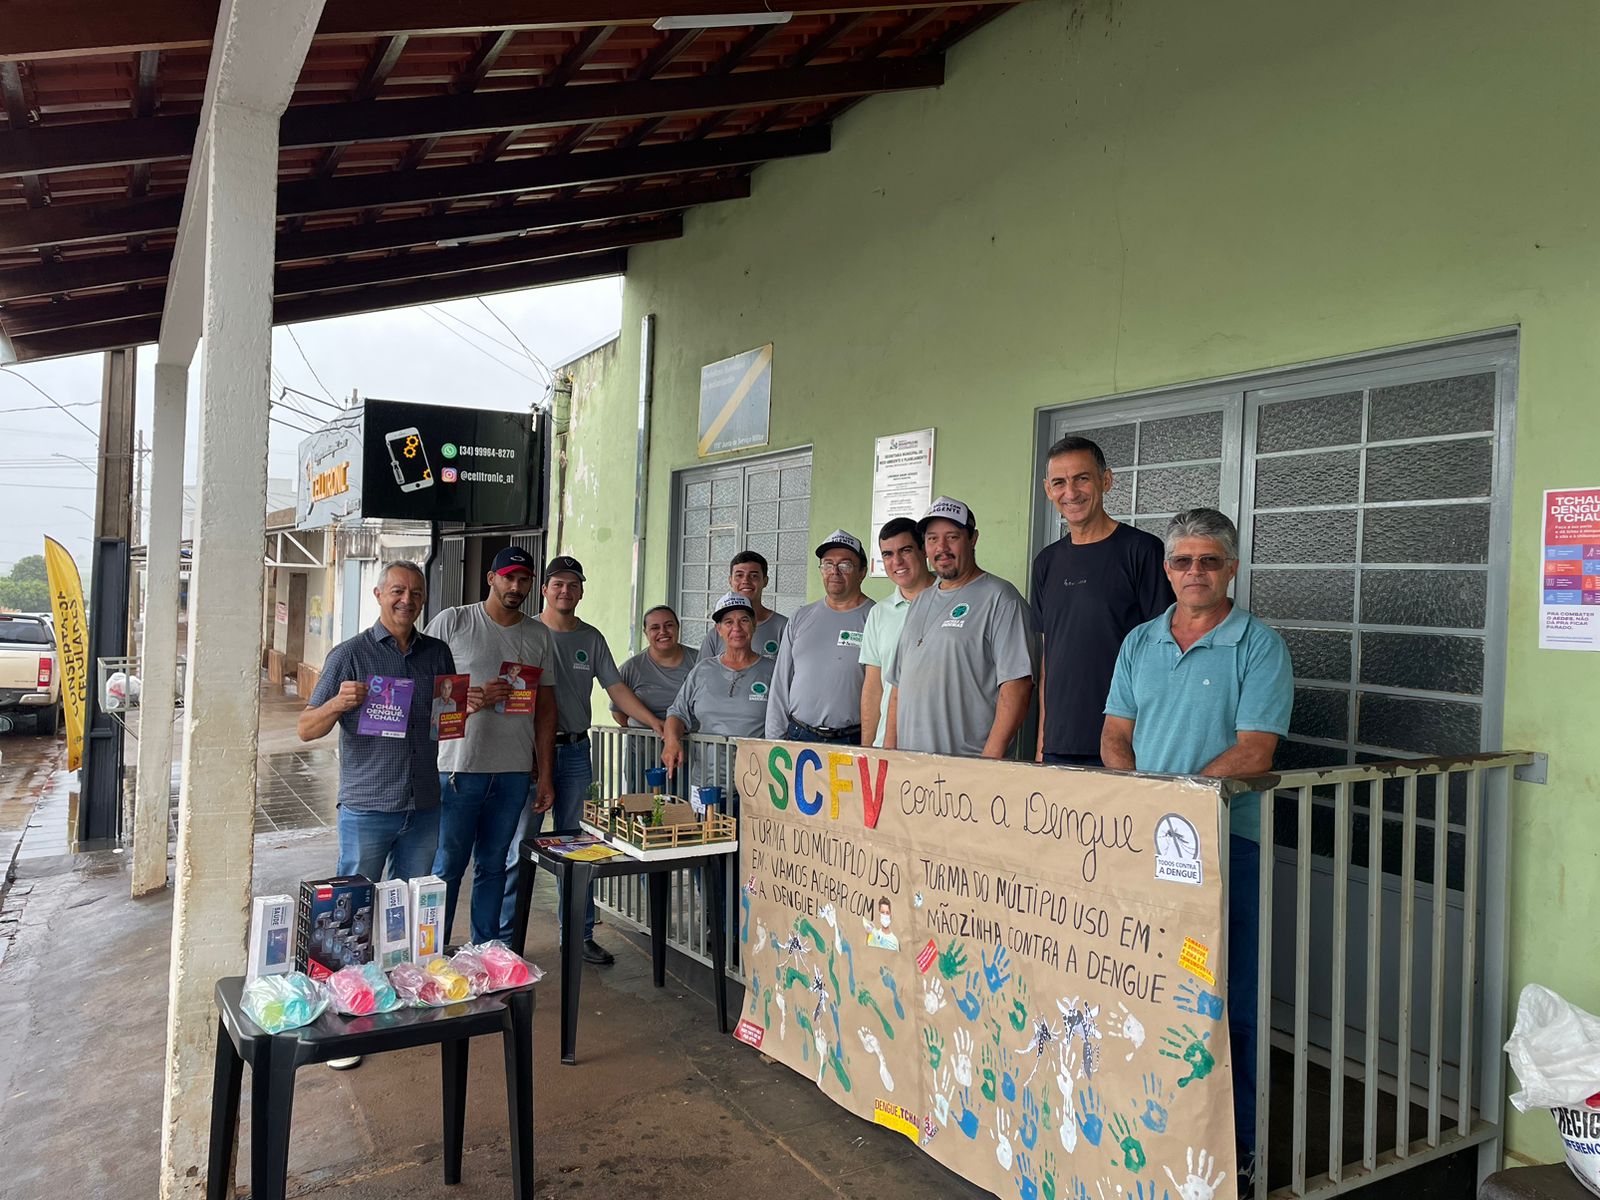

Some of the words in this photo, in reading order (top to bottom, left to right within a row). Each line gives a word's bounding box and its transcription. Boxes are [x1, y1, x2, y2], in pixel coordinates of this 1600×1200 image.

[459, 445, 474, 456] (34)
[474, 447, 515, 459] 99964-8270
[460, 470, 514, 484] @celltronic_at
[1551, 504, 1600, 514] DENGU
[768, 746, 889, 829] SCFV
[990, 795, 1011, 828] a
[1023, 791, 1143, 883] Dengue
[747, 815, 787, 852] TURMA
[793, 828, 810, 857] DO
[868, 853, 901, 894] USO
[1158, 859, 1175, 867] TODOS
[1175, 861, 1197, 870] CONTRA
[771, 858, 808, 888] VAMOS
[811, 869, 849, 911] ACABAR
[850, 890, 875, 921] COM
[1166, 867, 1197, 879] DENGUE
[758, 880, 767, 900] A
[772, 884, 819, 919] DENGUE!
[920, 858, 970, 898] TURMA
[973, 870, 989, 903] DO
[1073, 901, 1109, 938] USO
[1008, 926, 1059, 971] CONTRA
[1066, 944, 1077, 973] A
[1087, 950, 1166, 1003] DENGUE
[1559, 1107, 1600, 1139] RECIC
